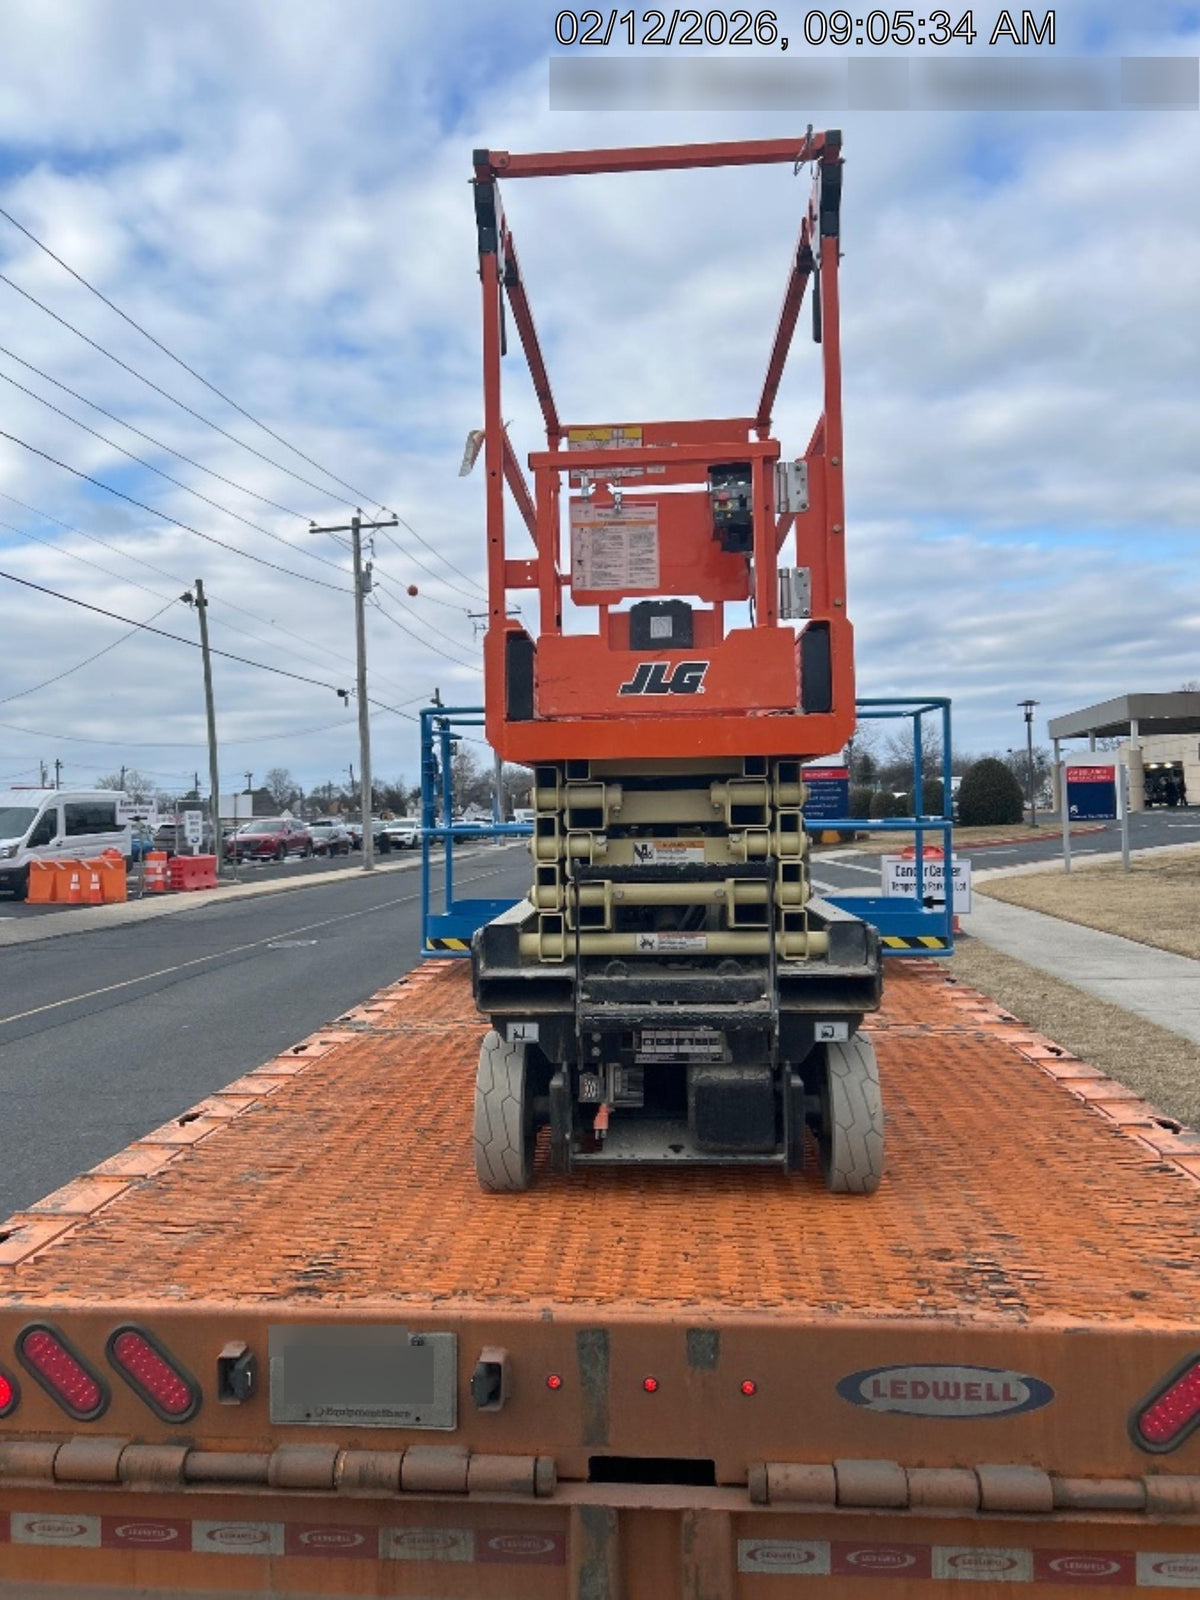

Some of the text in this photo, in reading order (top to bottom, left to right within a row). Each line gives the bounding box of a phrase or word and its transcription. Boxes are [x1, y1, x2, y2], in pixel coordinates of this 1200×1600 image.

[617, 661, 708, 697] JLG
[895, 865, 929, 878] Cancr
[872, 1379, 1018, 1402] LEDWELL
